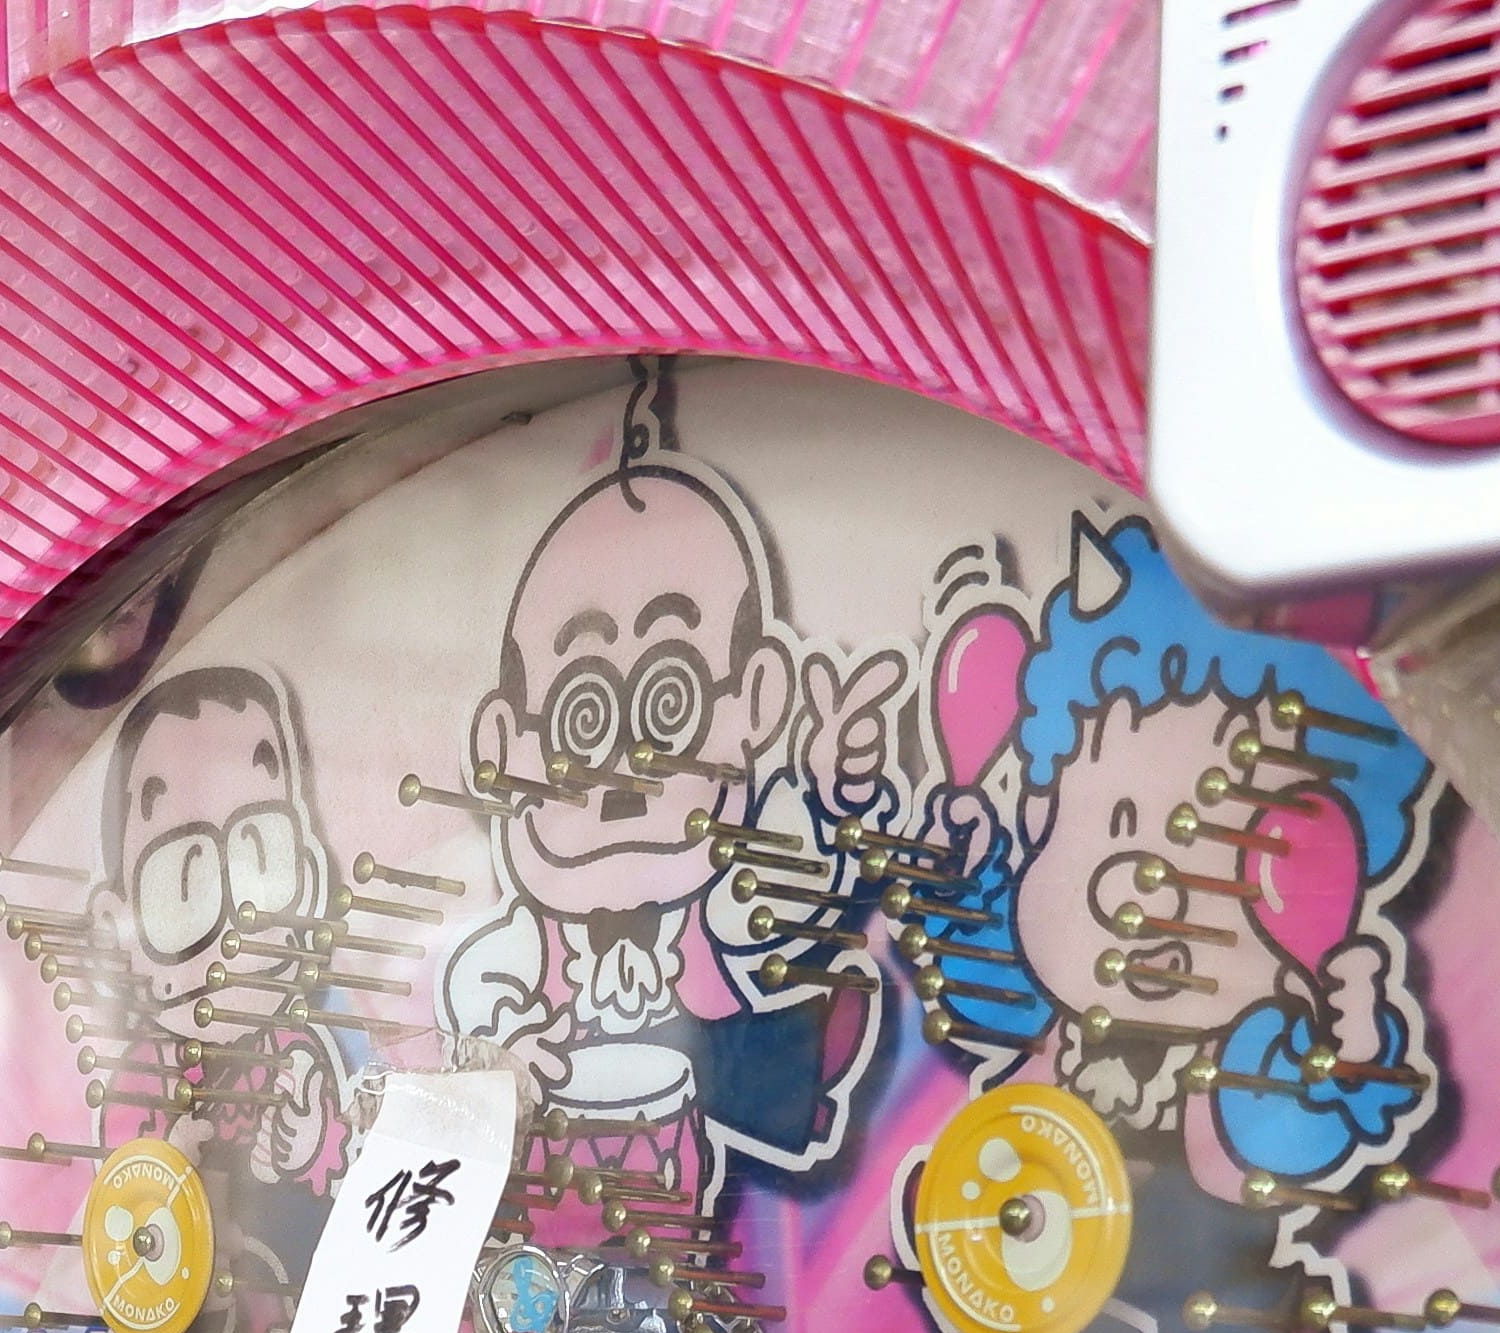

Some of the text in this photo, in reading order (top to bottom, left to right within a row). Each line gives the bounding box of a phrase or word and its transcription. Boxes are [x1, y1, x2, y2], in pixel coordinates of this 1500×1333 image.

[112, 1165, 175, 1192] MONAKO
[1021, 1115, 1099, 1204] MONAKO
[939, 1232, 1015, 1323] MONAKO
[112, 1294, 176, 1322] MONAKO
